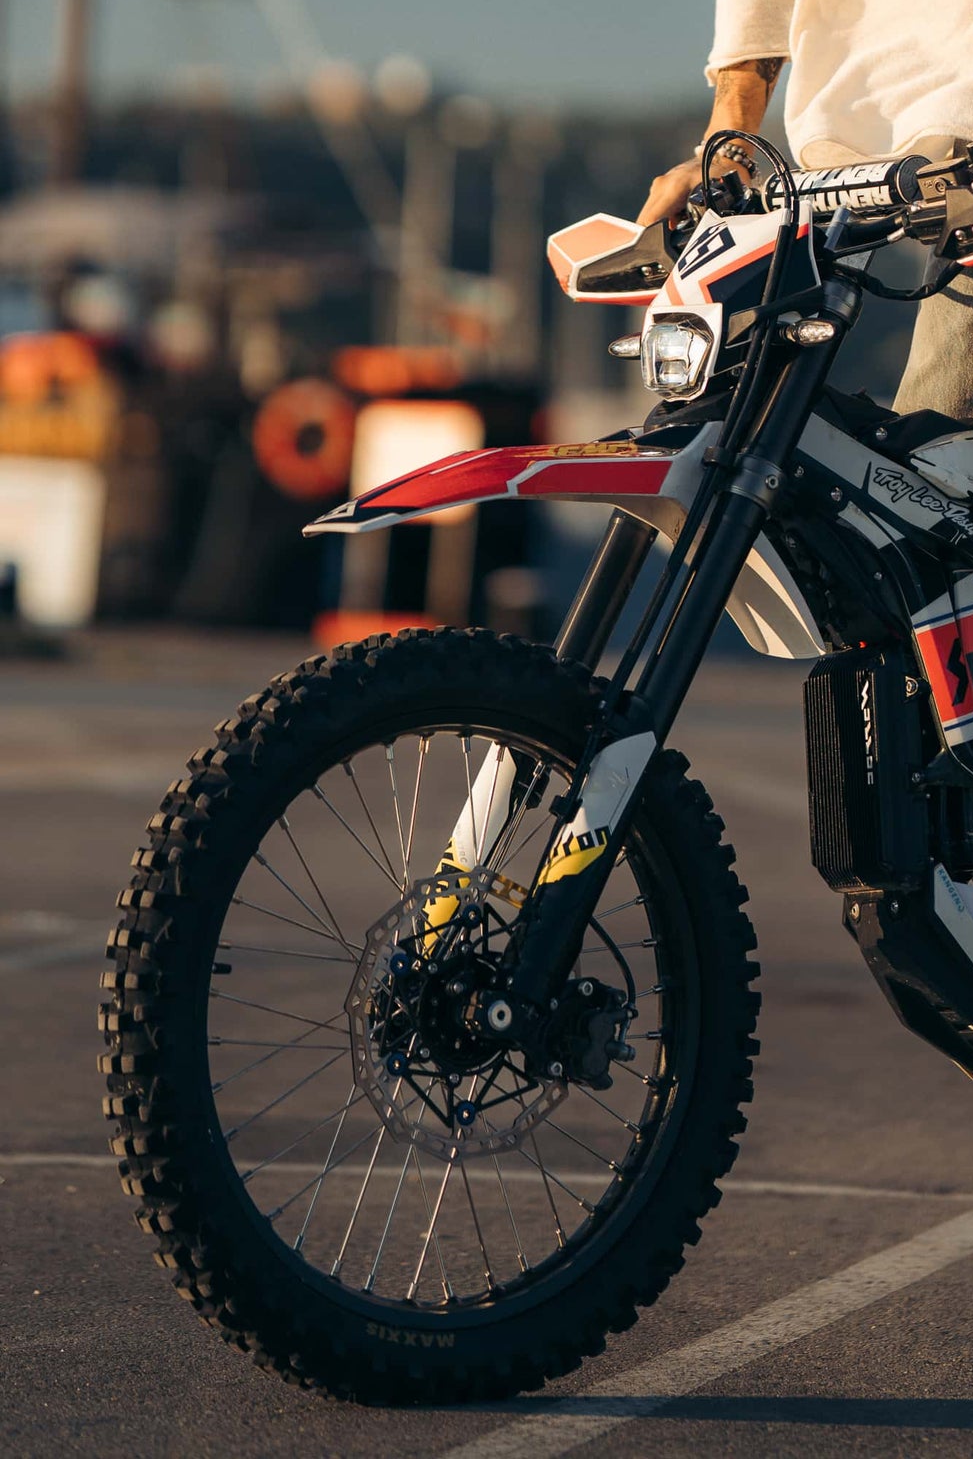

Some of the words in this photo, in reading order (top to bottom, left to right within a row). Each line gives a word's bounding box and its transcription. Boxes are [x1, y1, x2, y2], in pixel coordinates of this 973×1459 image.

[772, 185, 894, 213] RENTHL
[873, 467, 912, 503] Troy
[911, 486, 945, 514] Lee
[366, 1322, 455, 1348] MAXXIS
